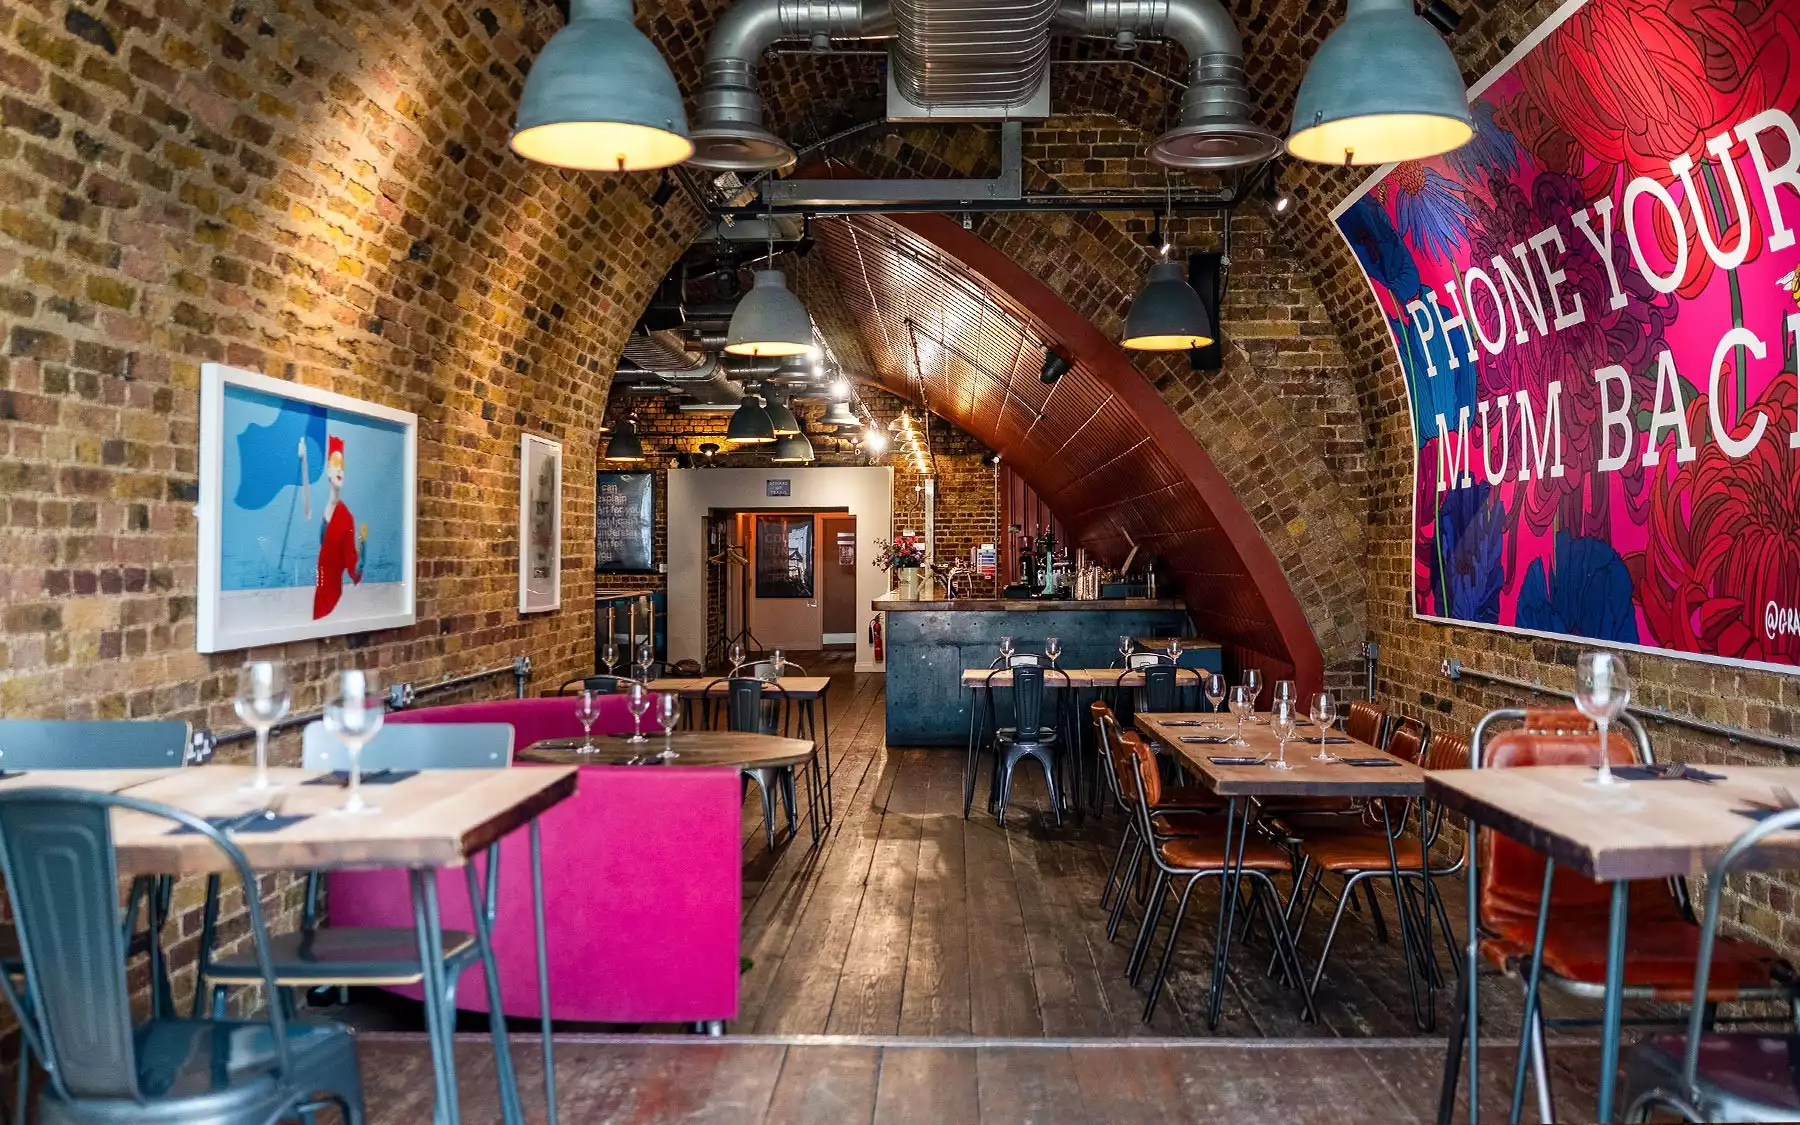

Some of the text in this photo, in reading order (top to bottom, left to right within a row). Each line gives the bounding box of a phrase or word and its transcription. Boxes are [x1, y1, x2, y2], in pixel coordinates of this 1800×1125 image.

[1406, 108, 1800, 377] PHONE YOUR
[1435, 313, 1800, 492] MUM BAC
[1765, 600, 1800, 639] @GRA
